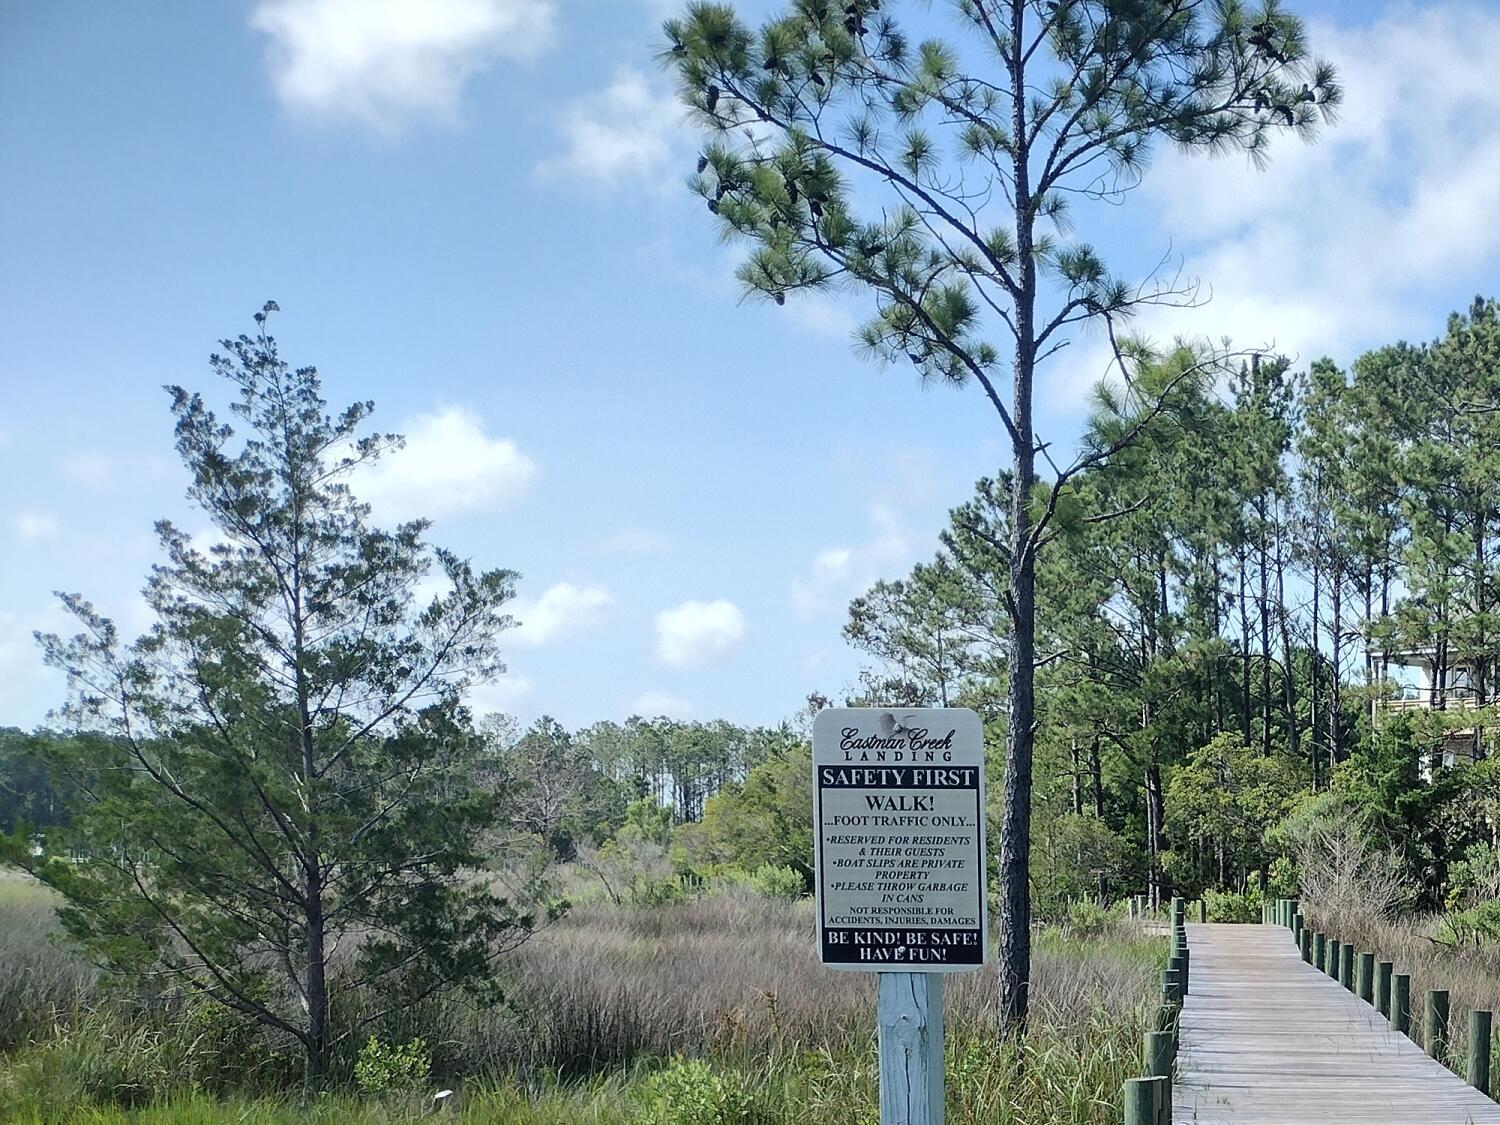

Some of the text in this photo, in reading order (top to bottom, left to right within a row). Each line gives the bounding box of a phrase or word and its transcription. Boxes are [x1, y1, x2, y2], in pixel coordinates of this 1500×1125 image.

[840, 728, 955, 750] Eastman Creek
[845, 751, 952, 761] LANDING
[823, 769, 975, 786] SAFETY FIRST
[865, 795, 935, 811] WALK!
[872, 816, 929, 826] TRAFFIC
[888, 836, 909, 845] FOR
[912, 837, 970, 845] RESIDENTS
[858, 848, 945, 857] & THEIR GUESTS
[867, 859, 895, 868] SLIPS
[897, 860, 918, 868] ARE
[921, 860, 965, 868] PRIVATE
[875, 871, 930, 879] PROPERTY
[877, 882, 916, 891] THROW
[918, 883, 968, 892] GARBAGE
[882, 894, 924, 903] IN CANS
[871, 907, 933, 915] RESPONSIBLE
[828, 917, 883, 925] ACCIDENTS,
[885, 917, 929, 926] INJURIES,
[828, 932, 978, 946] BE KIND! BE SAFE!
[860, 948, 947, 961] HAVE FUN!
